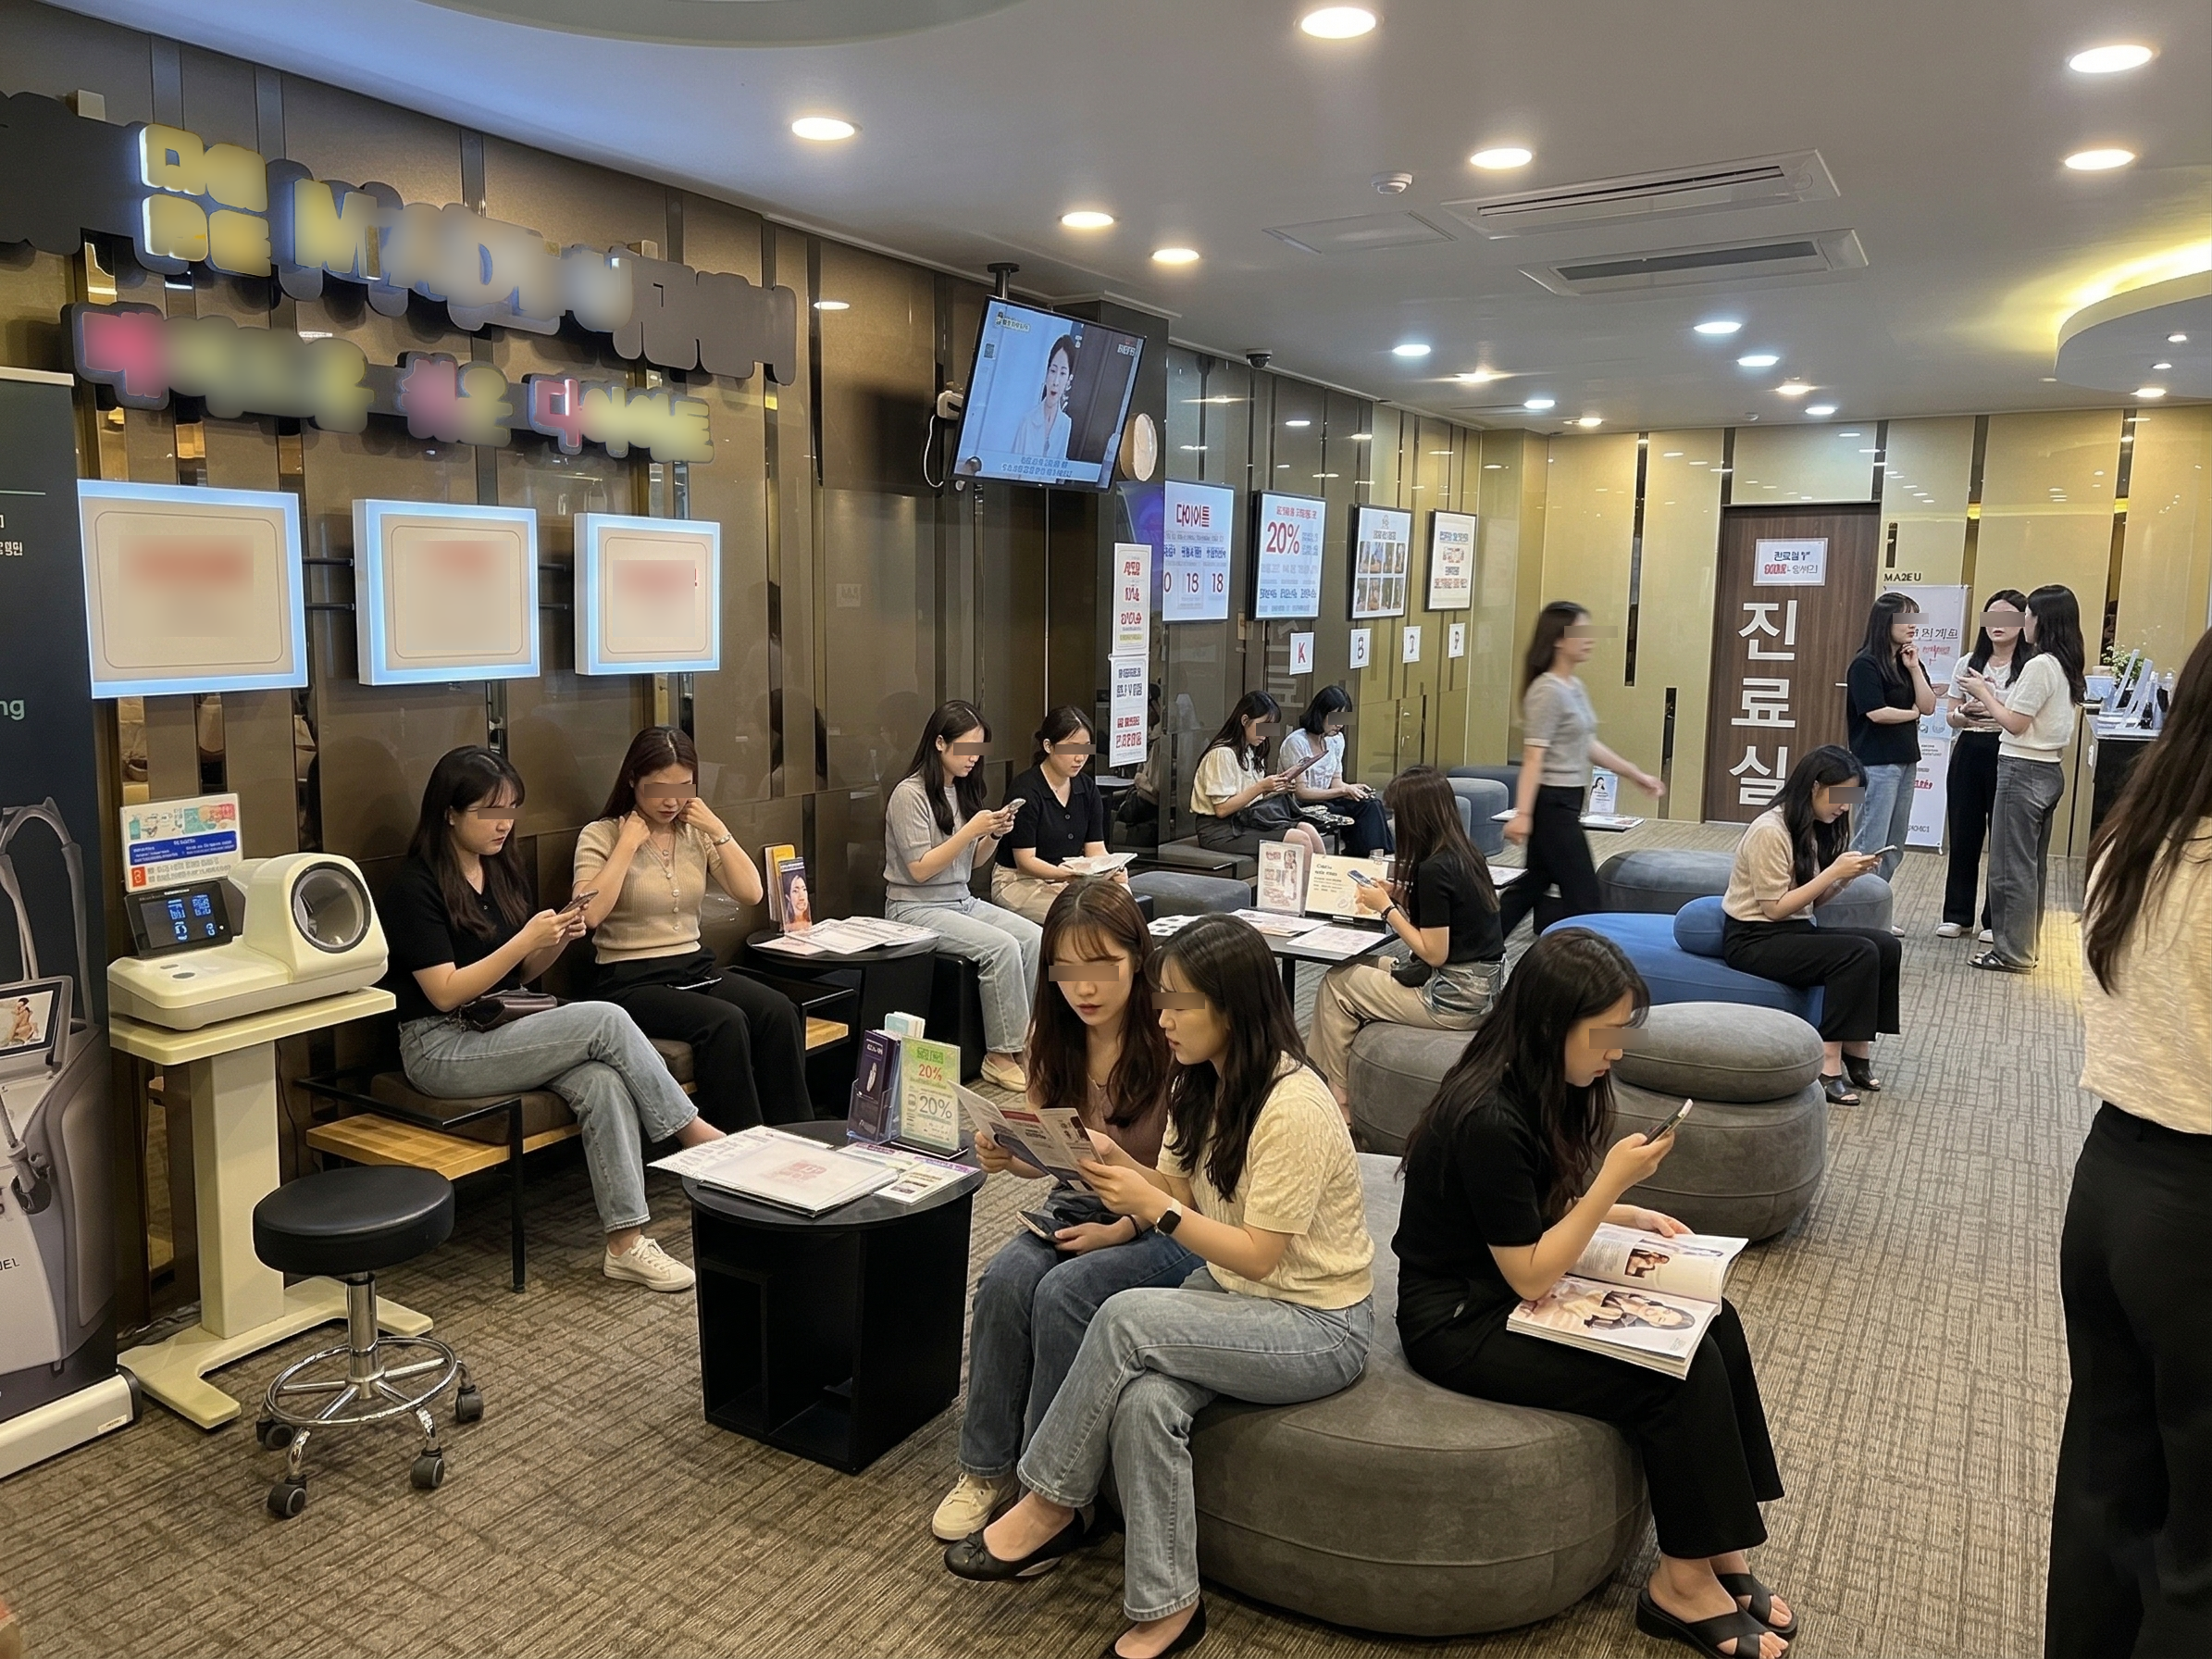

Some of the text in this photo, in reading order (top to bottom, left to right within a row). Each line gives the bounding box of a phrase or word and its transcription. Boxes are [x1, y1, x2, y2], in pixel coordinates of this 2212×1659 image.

[1266, 521, 1300, 555] 20%
[1728, 600, 1799, 806] 진료실
[919, 1095, 952, 1119] 20%
